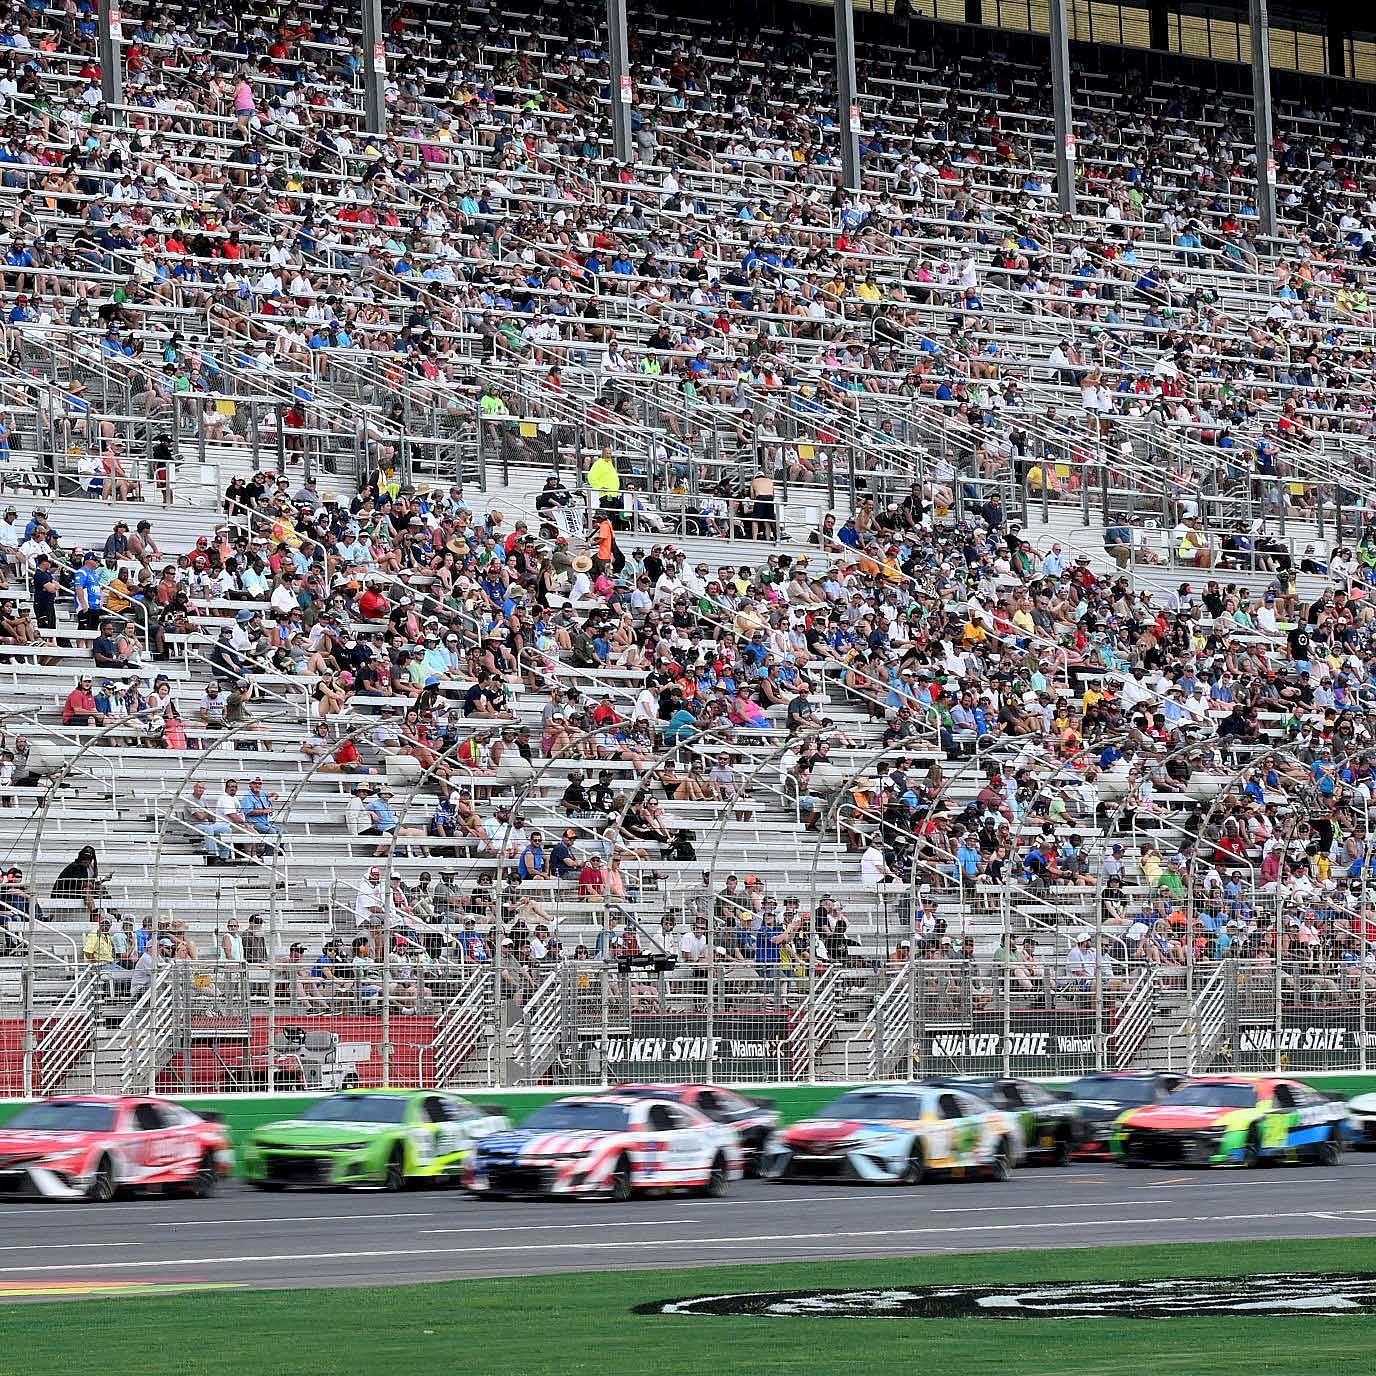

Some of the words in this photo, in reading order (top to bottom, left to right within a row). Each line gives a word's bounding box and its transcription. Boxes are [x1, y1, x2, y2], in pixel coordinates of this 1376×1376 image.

[670, 1036, 723, 1061] STATE
[730, 1039, 771, 1058] Walmart
[932, 1033, 1000, 1056] QUAKER
[1002, 1032, 1049, 1055] STATE
[1058, 1035, 1096, 1053] Walmart
[1303, 1027, 1347, 1050] STATE
[1353, 1031, 1376, 1047] Wlm
